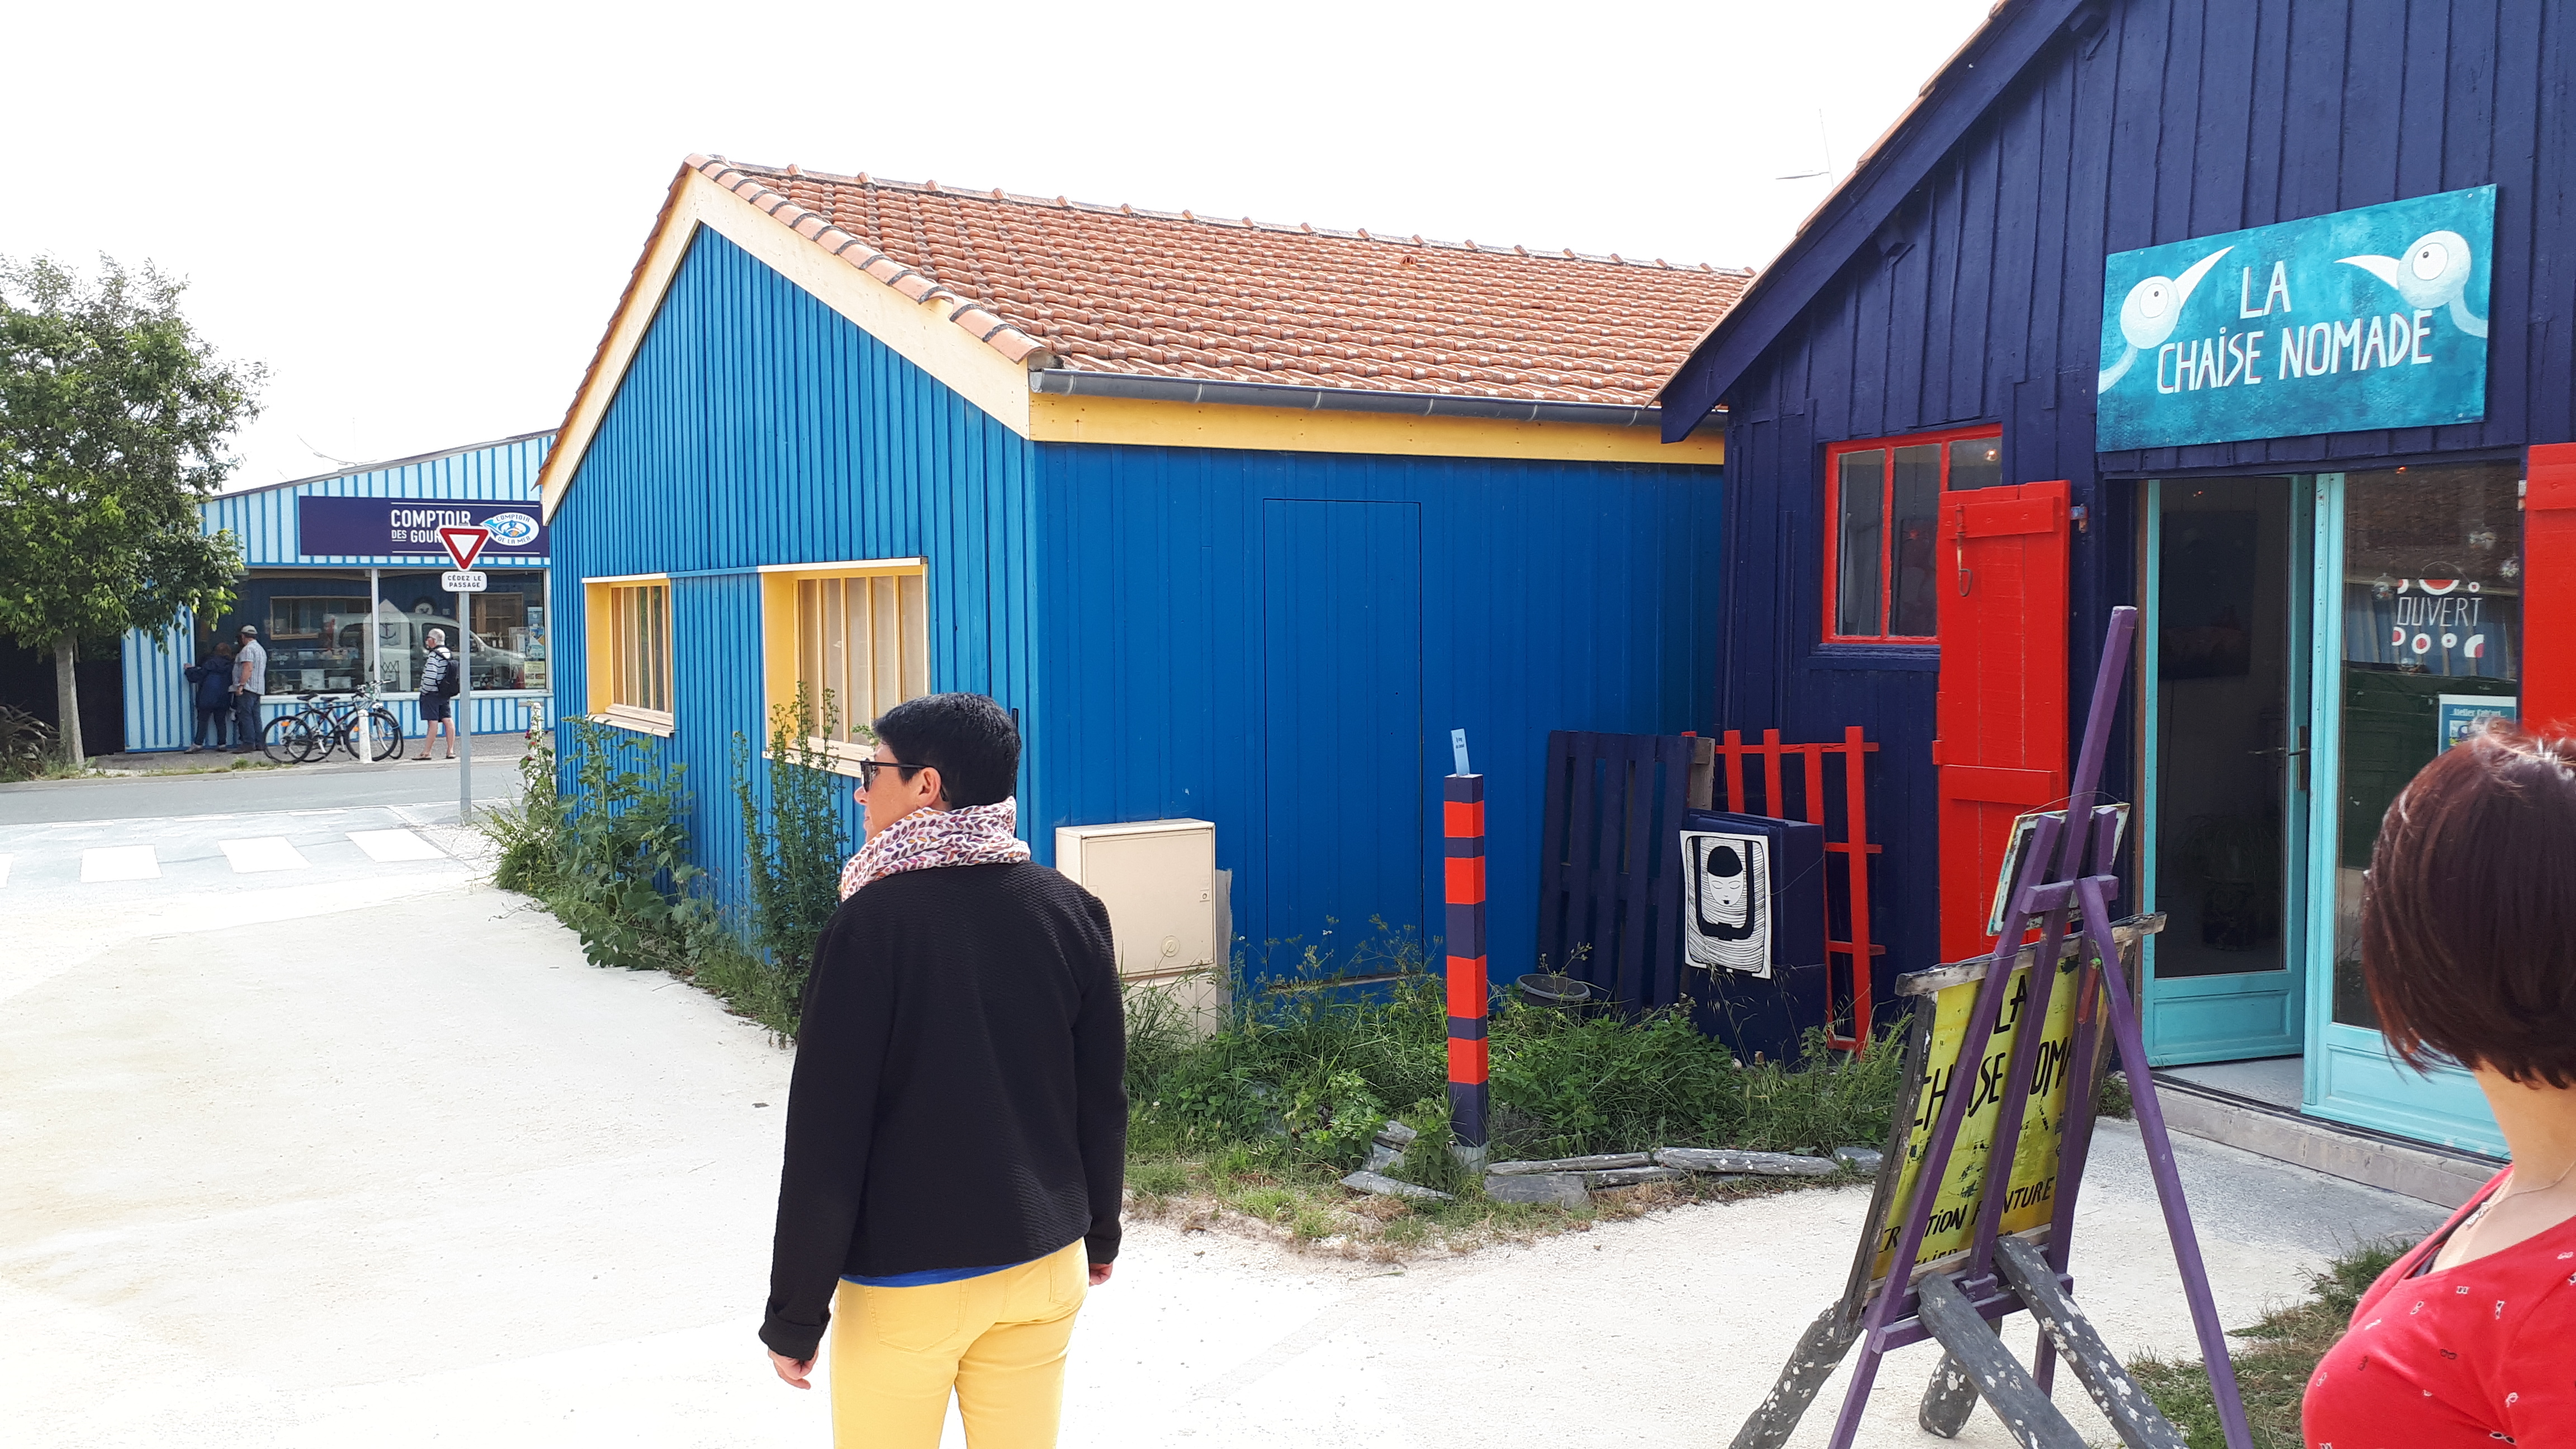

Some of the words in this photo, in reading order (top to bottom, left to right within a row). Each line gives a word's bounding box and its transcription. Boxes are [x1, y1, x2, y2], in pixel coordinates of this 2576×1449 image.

[2239, 260, 2291, 319] LA
[2279, 309, 2433, 380] NOMADE
[391, 509, 471, 528] COMPTOIR
[496, 514, 531, 523] COMPTOIR
[391, 529, 407, 539] DES
[410, 530, 442, 543] GOUR
[517, 535, 531, 544] MER
[2397, 596, 2483, 627] OUVERT
